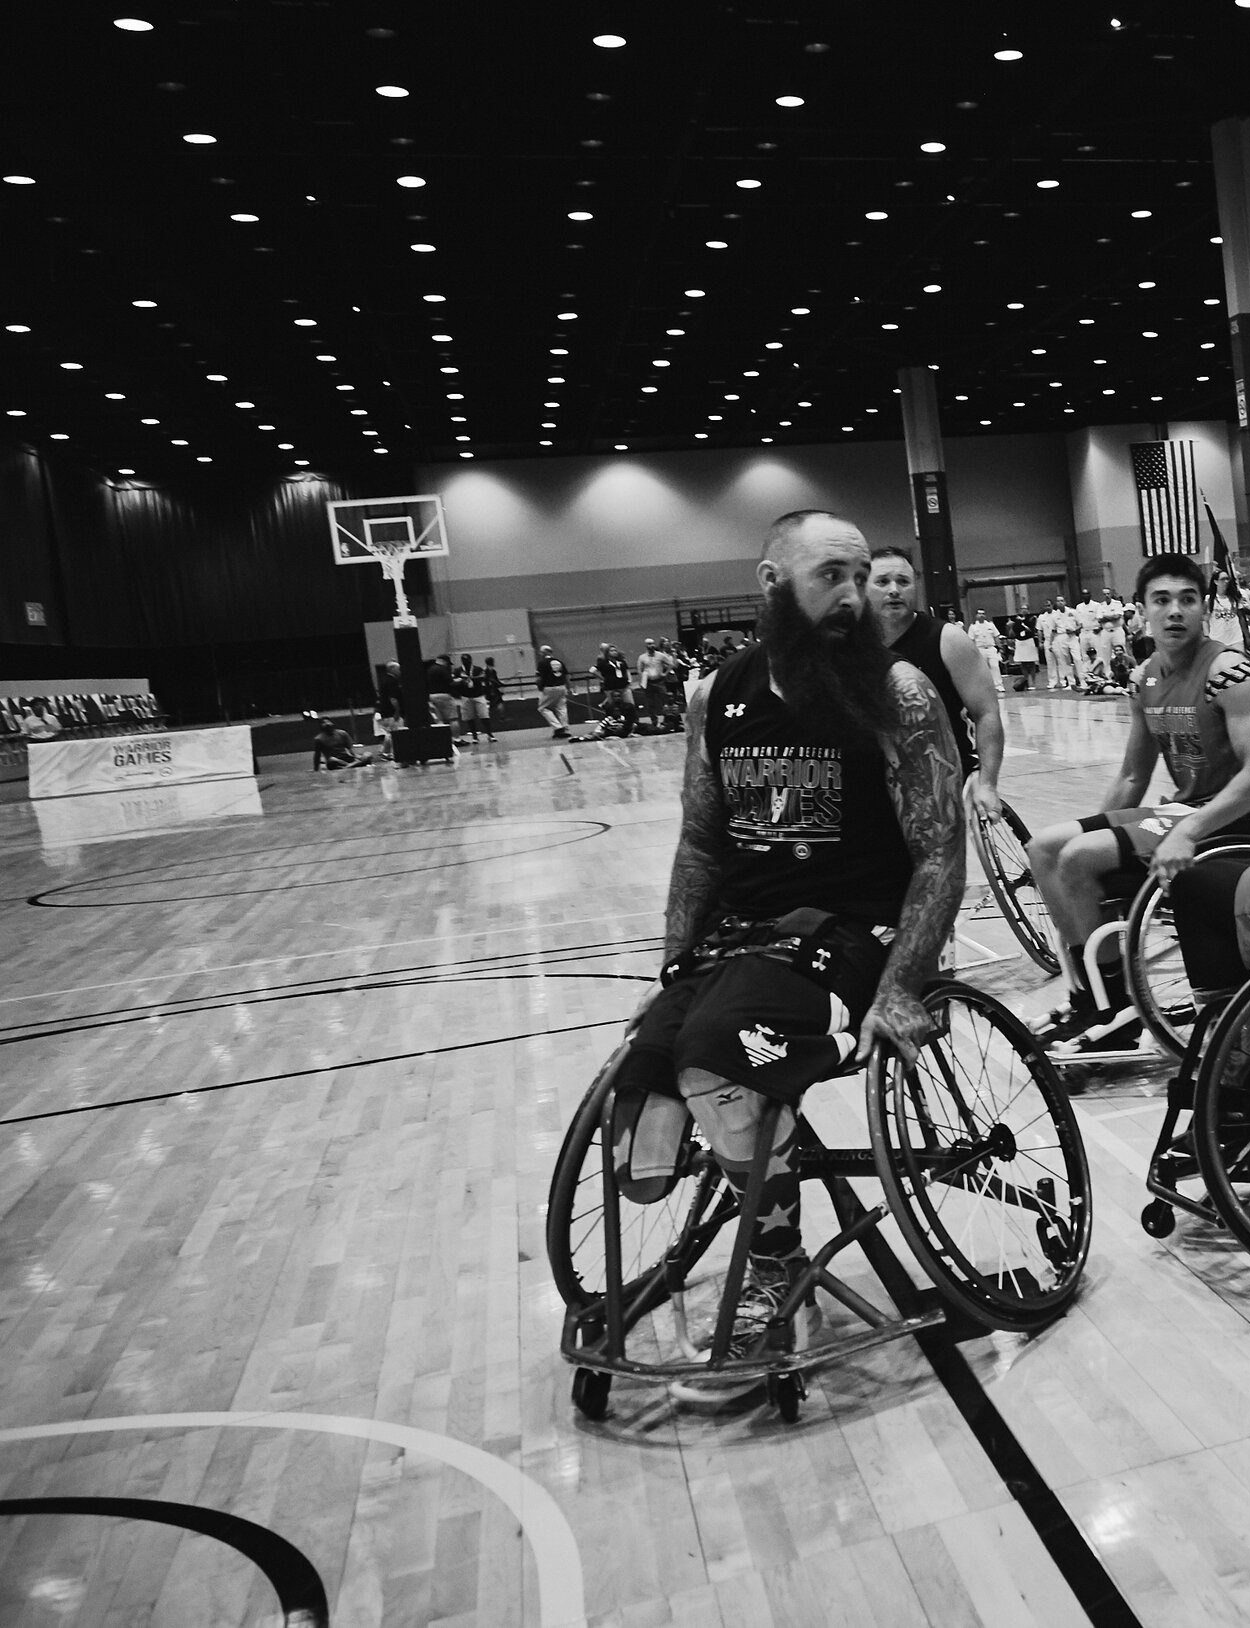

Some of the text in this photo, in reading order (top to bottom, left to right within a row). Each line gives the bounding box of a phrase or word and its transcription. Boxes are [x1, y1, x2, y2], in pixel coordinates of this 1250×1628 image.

[113, 740, 171, 753] WARRIOR
[783, 746, 796, 757] OF
[799, 746, 842, 759] DEFENSE
[114, 751, 172, 767] GAMES
[719, 758, 842, 790] WARRIOR
[722, 786, 842, 825] GAMES
